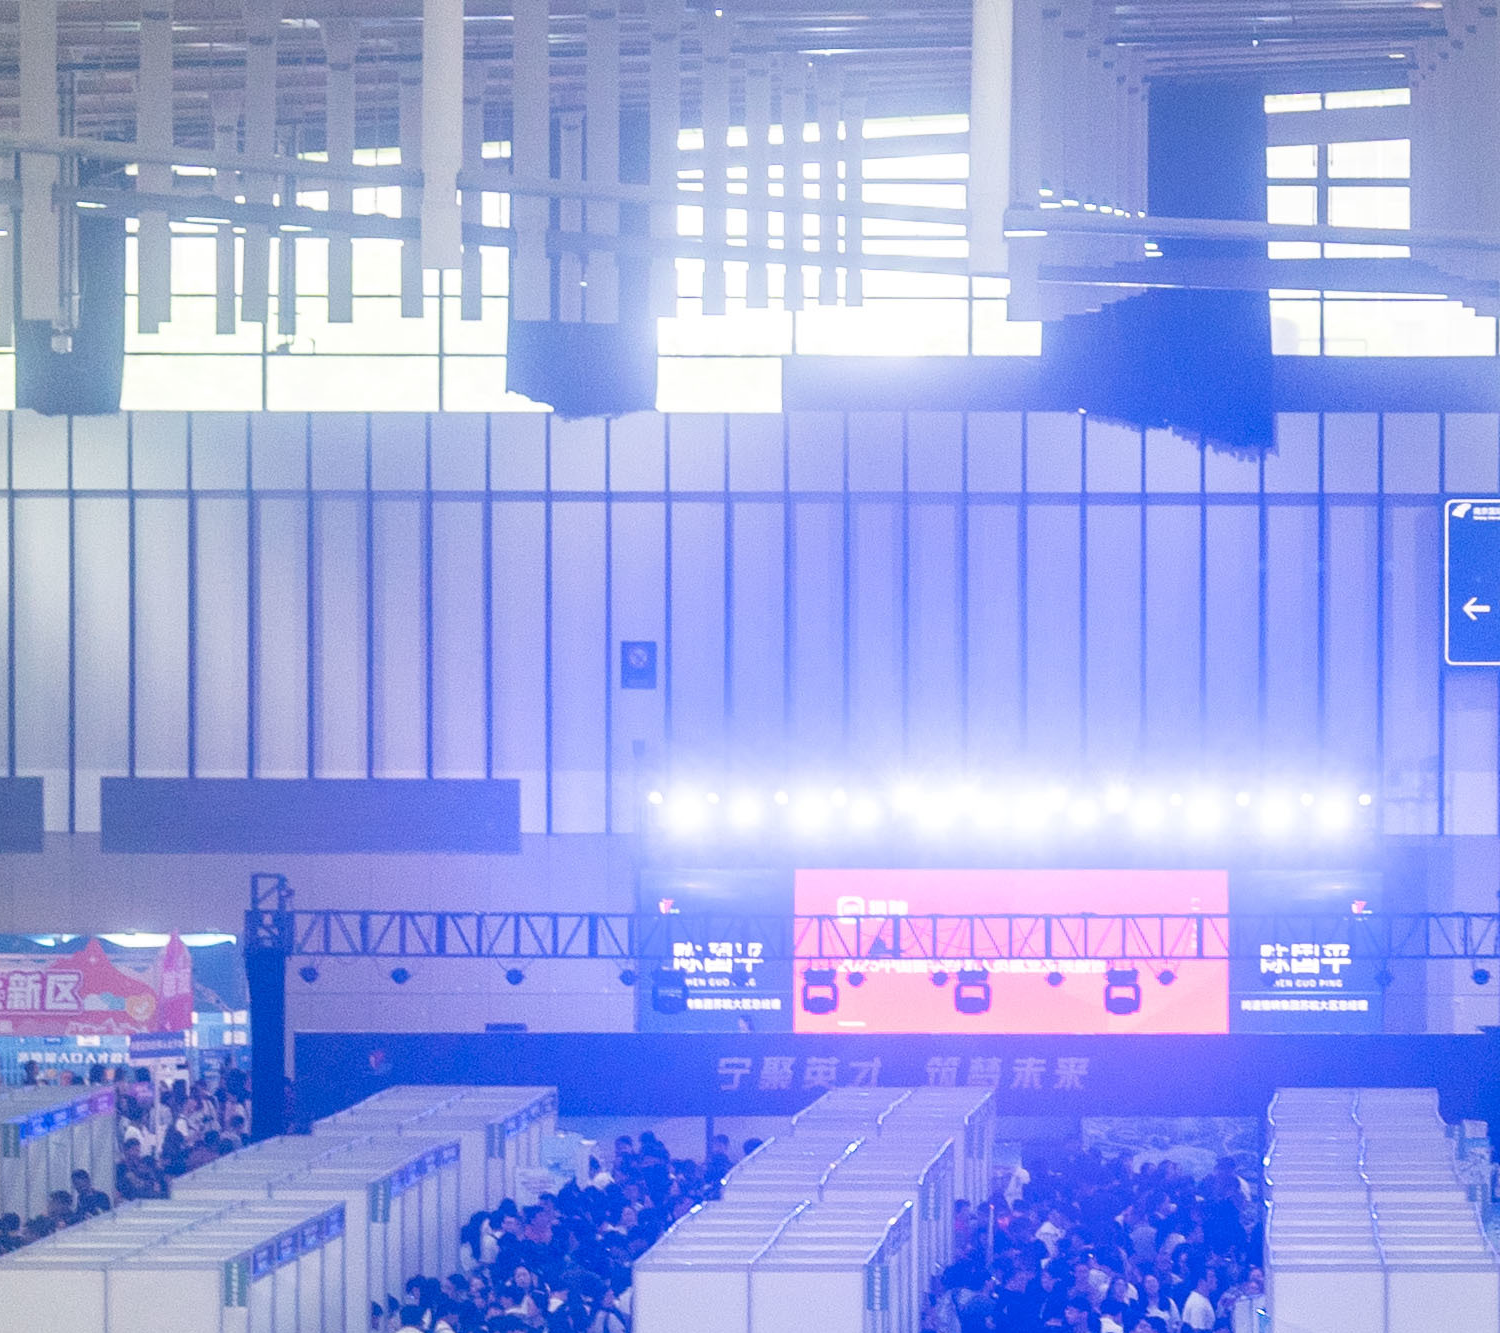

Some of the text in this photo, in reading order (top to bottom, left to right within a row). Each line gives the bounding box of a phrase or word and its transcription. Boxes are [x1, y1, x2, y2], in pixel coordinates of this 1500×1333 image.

[718, 1056, 1091, 1091] 宁聚英才 筑梦未来
